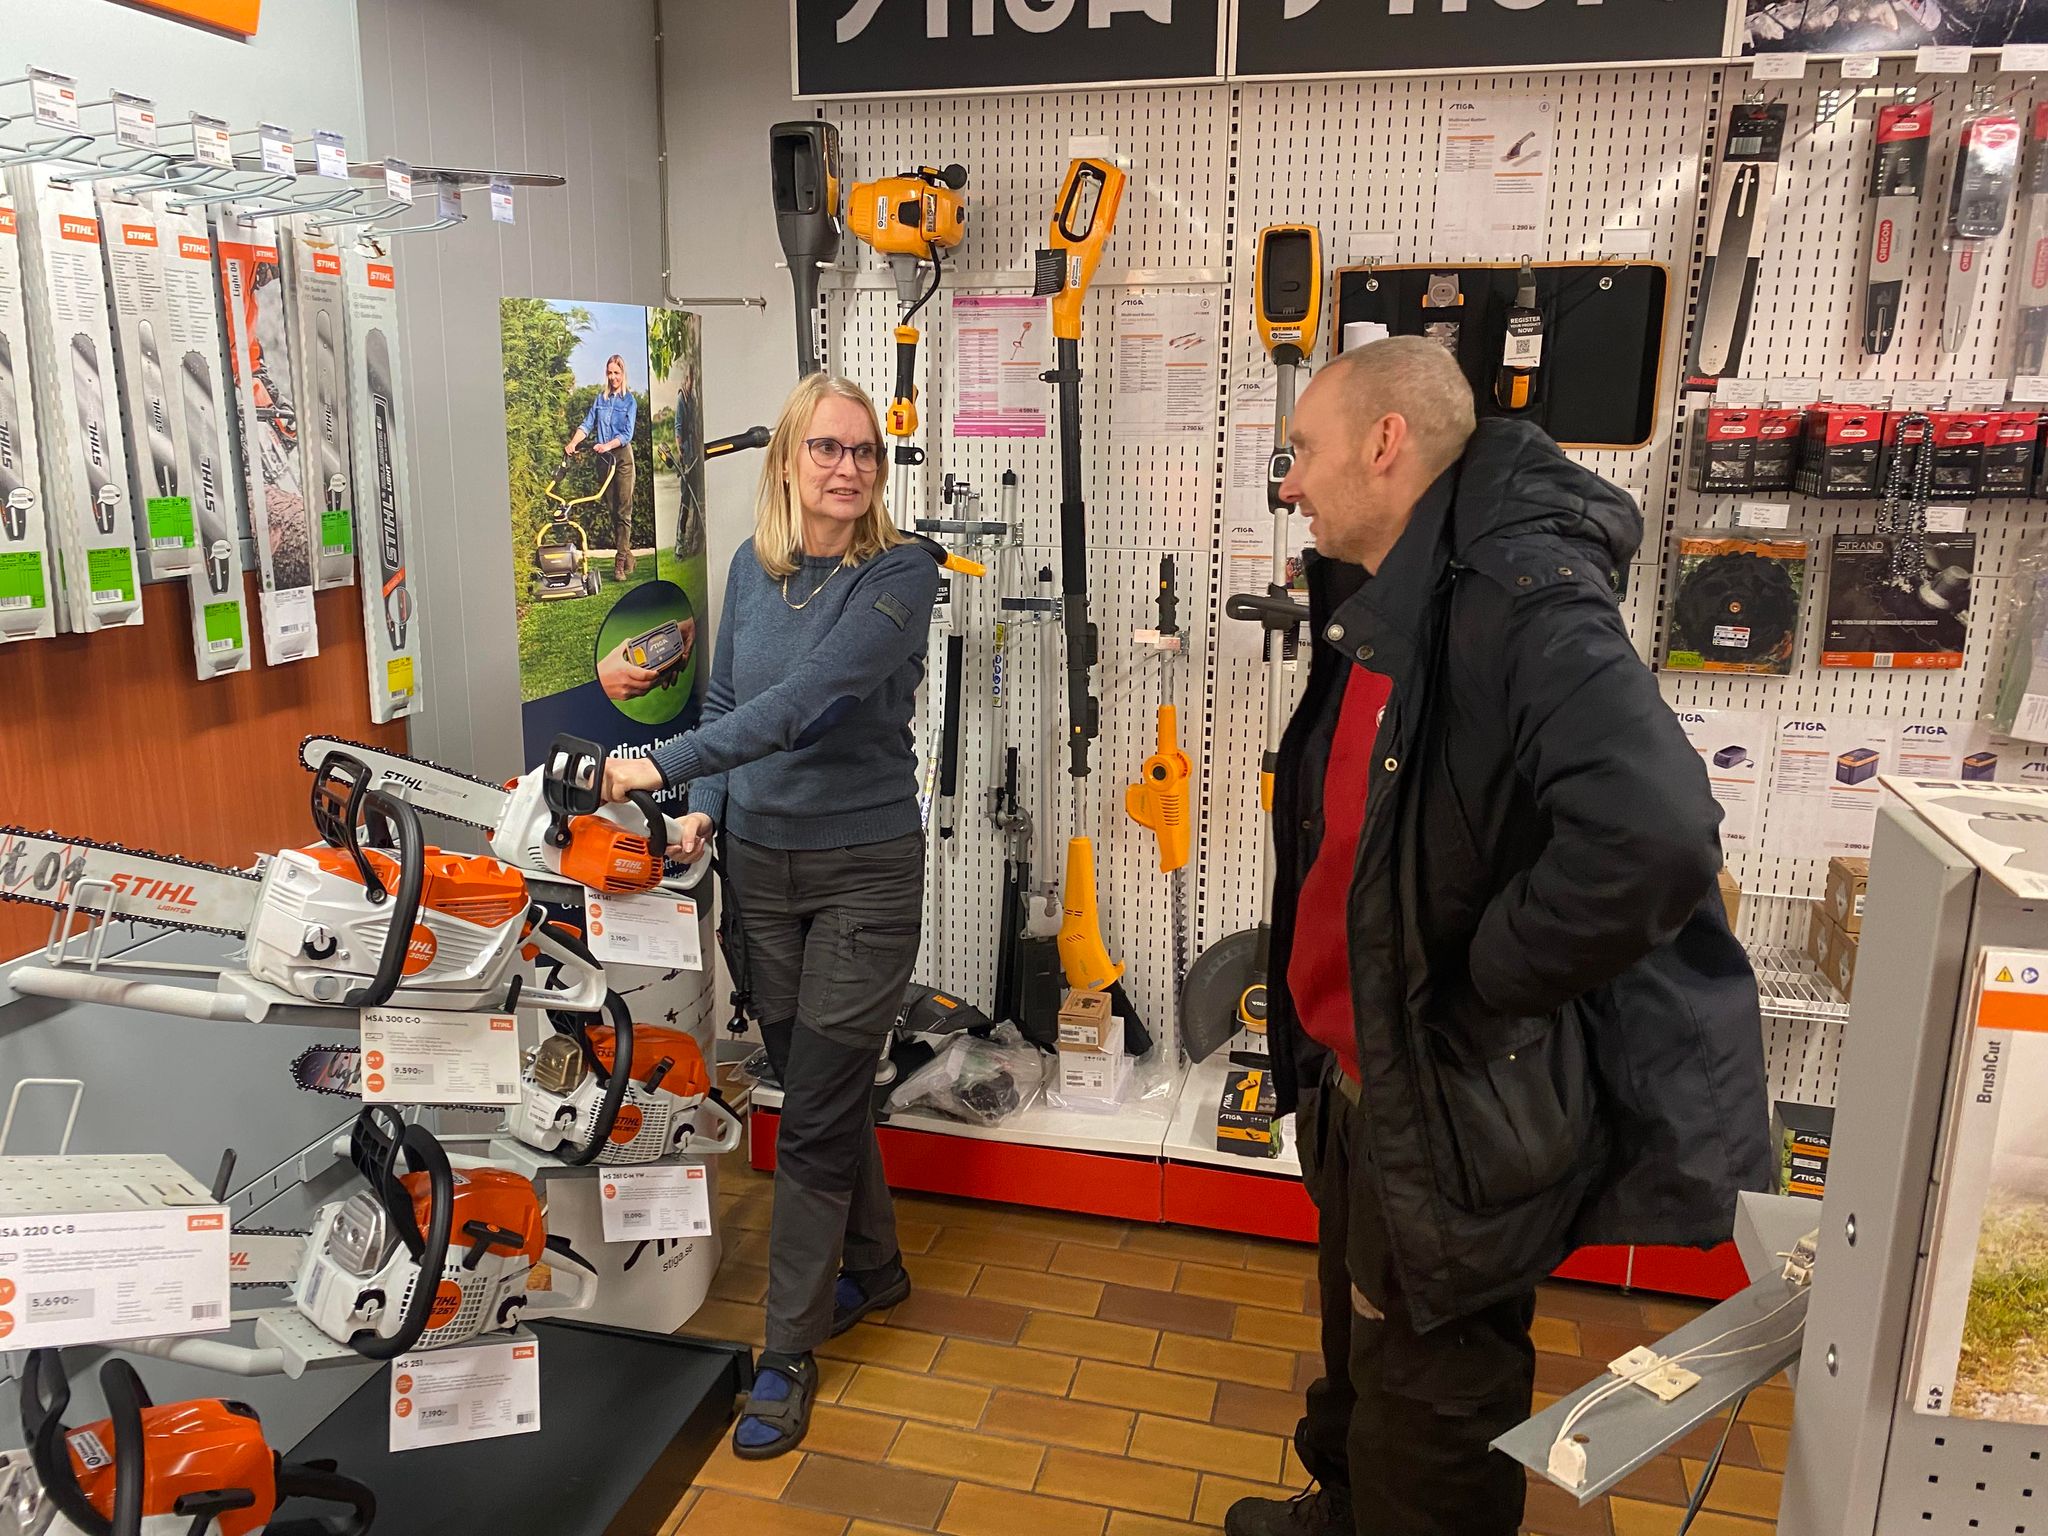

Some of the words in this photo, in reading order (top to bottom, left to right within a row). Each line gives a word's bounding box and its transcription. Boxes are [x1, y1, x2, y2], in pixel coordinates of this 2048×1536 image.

[63, 222, 95, 236] STIHL
[127, 231, 154, 241] STIHL
[1879, 222, 1891, 260] OREGON
[182, 243, 209, 254] STIHL
[256, 250, 276, 258] STIHL
[230, 261, 239, 273] 04
[316, 259, 339, 269] STIHL
[370, 272, 393, 282] STIHL
[232, 274, 241, 297] Light
[1510, 315, 1540, 324] REGISTER
[153, 398, 165, 433] STIHL
[325, 407, 334, 443] STIHL
[0, 420, 13, 469] STIHL
[88, 420, 102, 467] STIHL
[384, 465, 396, 492] LIGHT
[201, 457, 217, 513] STIHL
[381, 494, 399, 563] STIHL
[1837, 541, 1884, 550] STRAND
[650, 639, 669, 651] STIGA
[1676, 713, 1705, 723] TIGA
[1783, 721, 1827, 731] STIGA
[1903, 726, 1948, 735] STIGA
[380, 770, 423, 791] STIHL
[614, 858, 643, 870] STIHL
[103, 873, 197, 906] STIHL
[409, 940, 434, 954] IHL
[365, 1015, 383, 1023] MSA
[1976, 1041, 2001, 1104] BrushCut
[1223, 1093, 1234, 1108] STIGA
[1220, 1113, 1243, 1121] STIGA
[1796, 1135, 1828, 1145] STIGA
[1793, 1173, 1824, 1184] STIGA
[191, 1218, 221, 1227] STIHL
[0, 1227, 20, 1238] SA
[23, 1226, 49, 1237] 220
[52, 1225, 76, 1235] C-B
[662, 1243, 694, 1272] stiga.se
[434, 1295, 458, 1306] TIHL
[437, 1306, 455, 1315] 251
[411, 1359, 424, 1367] 251
